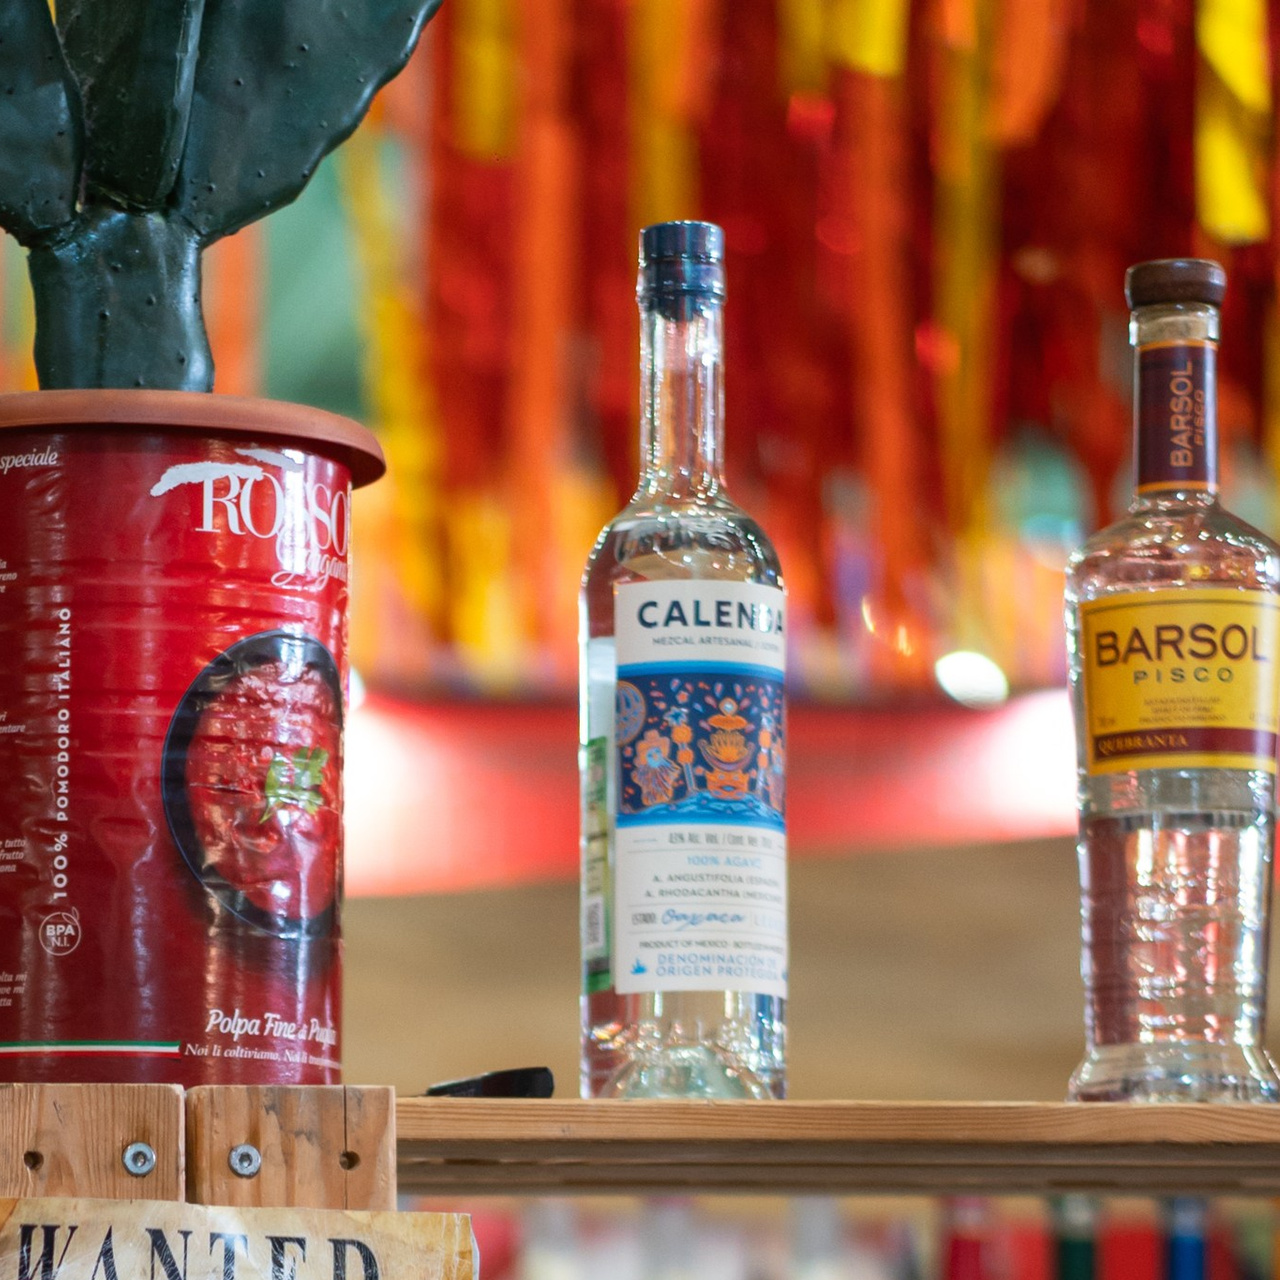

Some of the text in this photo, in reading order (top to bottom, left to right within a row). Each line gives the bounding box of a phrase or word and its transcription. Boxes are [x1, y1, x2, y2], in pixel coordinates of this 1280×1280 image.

[1170, 360, 1193, 467] BARSOL
[0, 445, 58, 475] speciale
[58, 607, 71, 699] ITALIANO
[1096, 622, 1270, 668] BARSOL
[1133, 666, 1235, 685] PISCO
[57, 708, 70, 821] POMODORO
[53, 833, 68, 899] 100%
[46, 925, 75, 936] BPA
[51, 936, 70, 947] N.I.
[656, 965, 712, 977] ORIGEN
[205, 1008, 297, 1041] Polpa Fine
[185, 1043, 208, 1056] Noi
